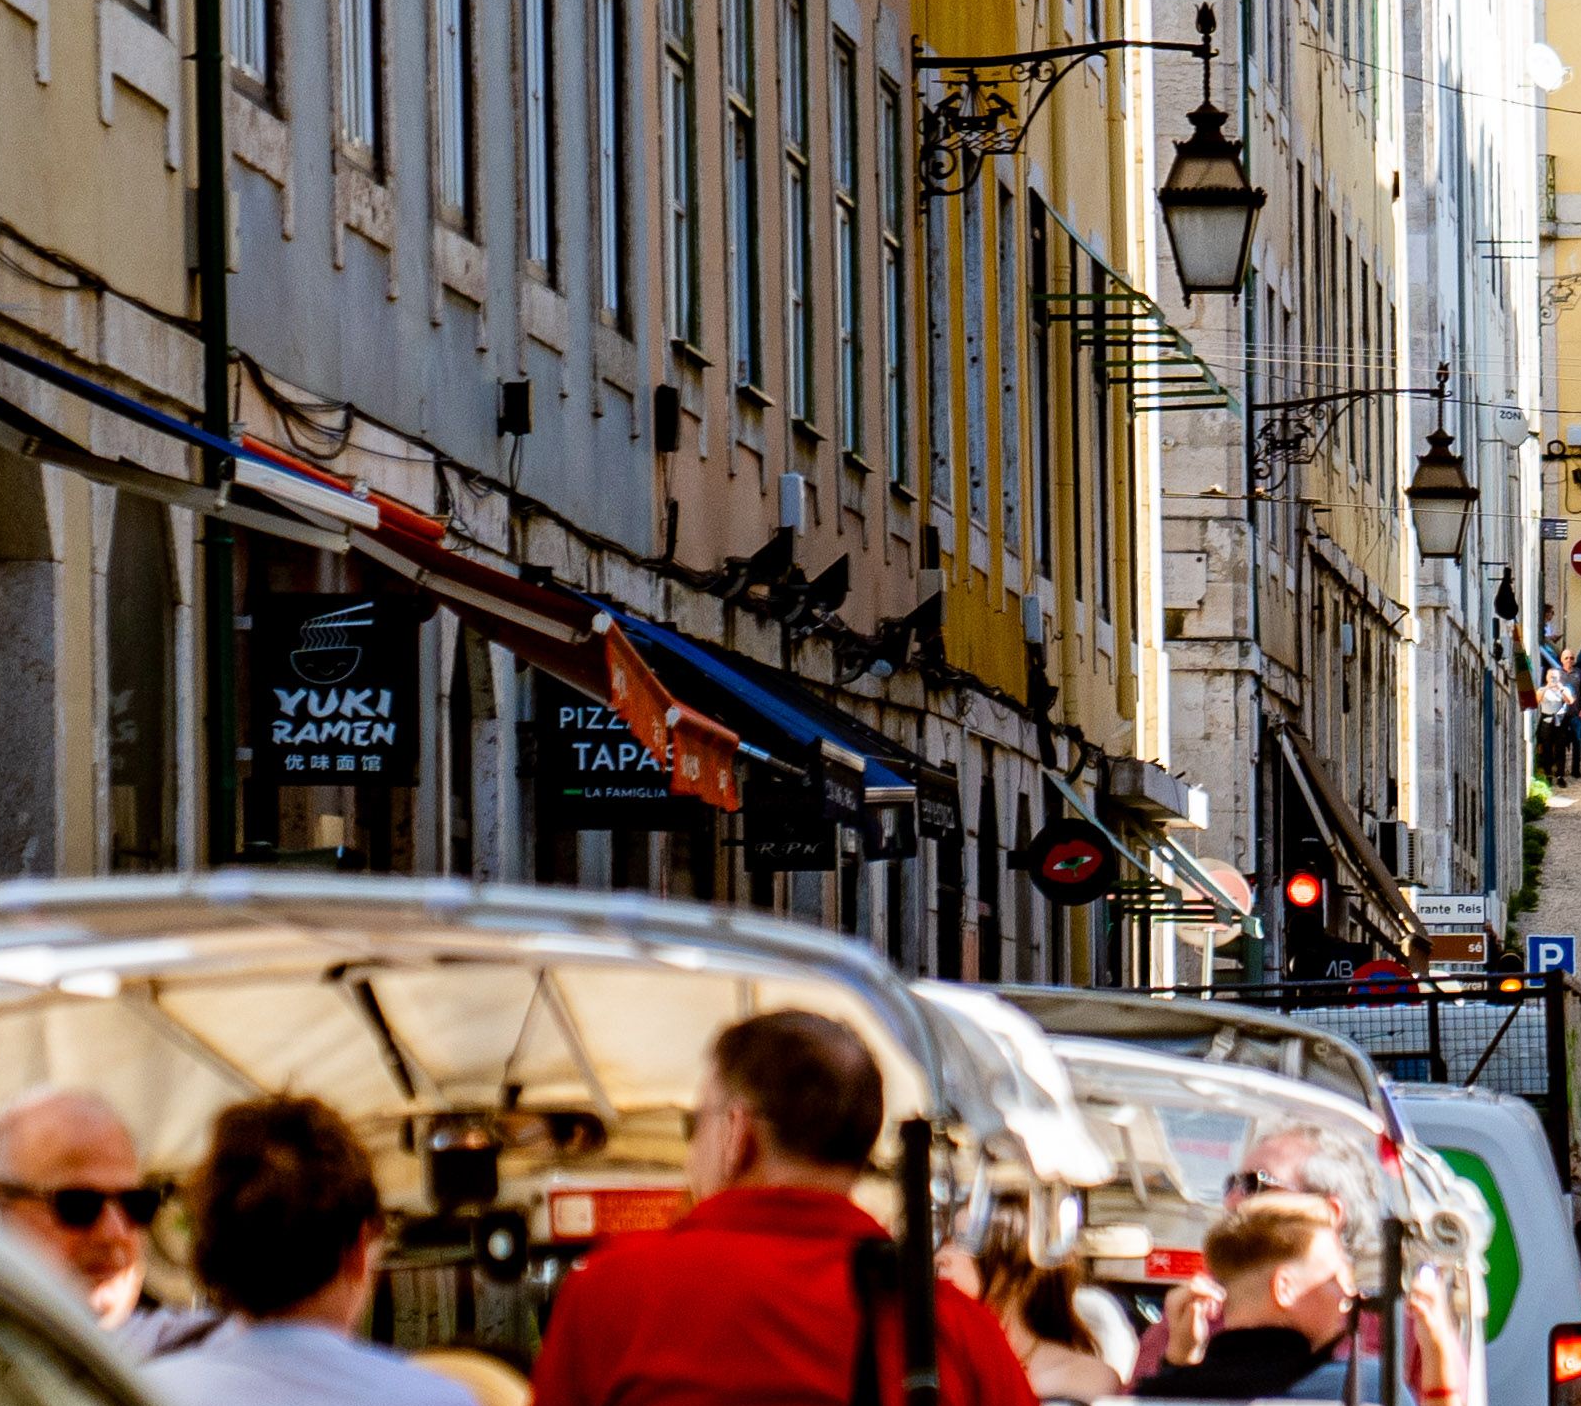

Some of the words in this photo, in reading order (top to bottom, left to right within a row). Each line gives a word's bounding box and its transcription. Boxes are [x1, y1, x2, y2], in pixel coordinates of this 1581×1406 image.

[272, 686, 393, 719] YUKI
[559, 706, 632, 730] PIZZ
[271, 719, 397, 747] RAMEN
[284, 753, 384, 772] 优味面馆
[584, 787, 601, 799] LA
[605, 787, 668, 799] FAMIGLIA
[1457, 903, 1482, 915] Reis
[1468, 941, 1483, 953] sé
